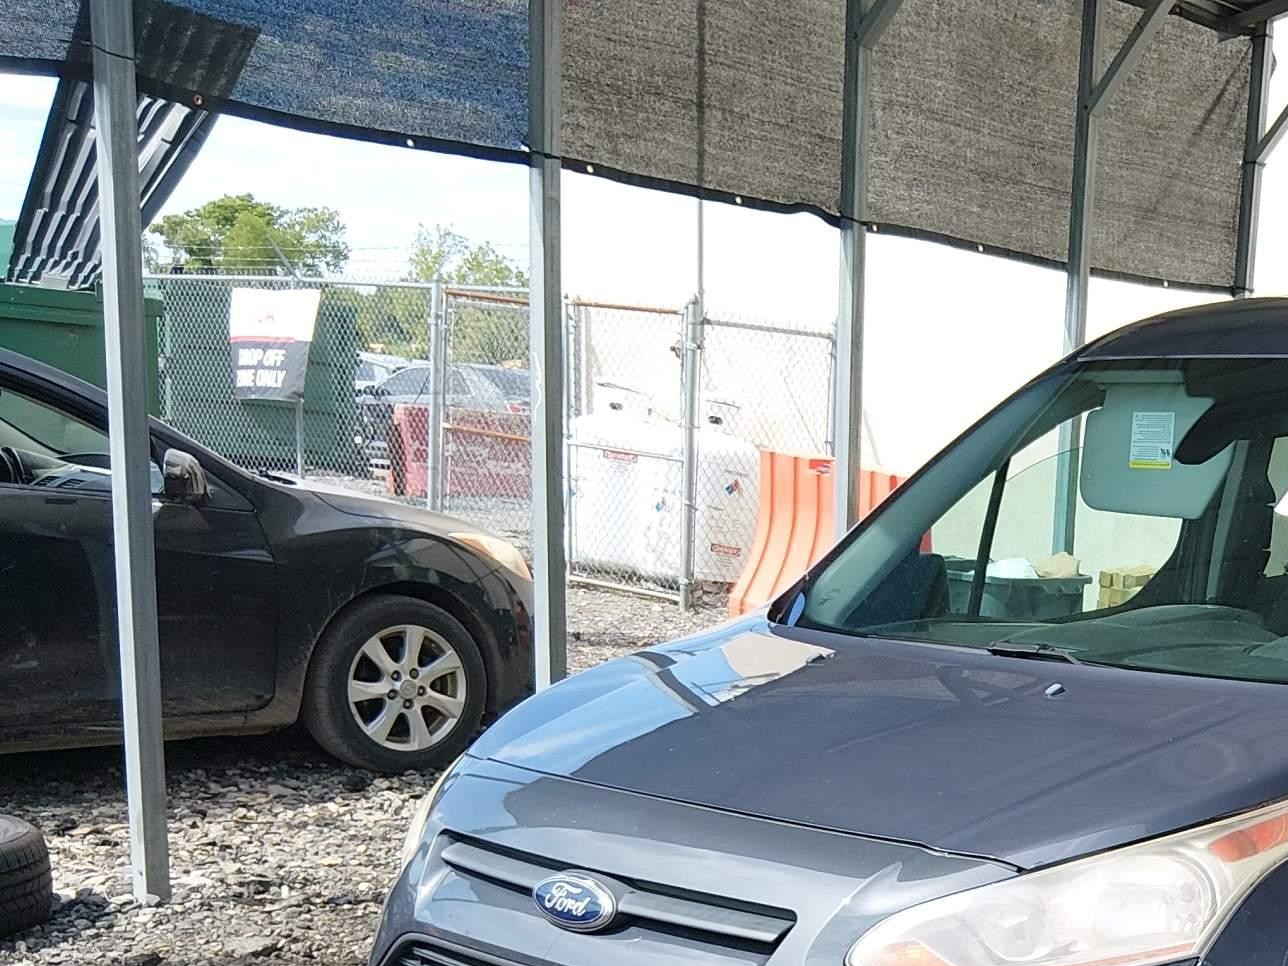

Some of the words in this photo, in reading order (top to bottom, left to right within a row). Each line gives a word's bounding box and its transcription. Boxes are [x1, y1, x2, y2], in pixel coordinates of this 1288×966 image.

[263, 349, 286, 367] OFF
[255, 369, 287, 388] ONLY
[544, 882, 592, 917] Ford
